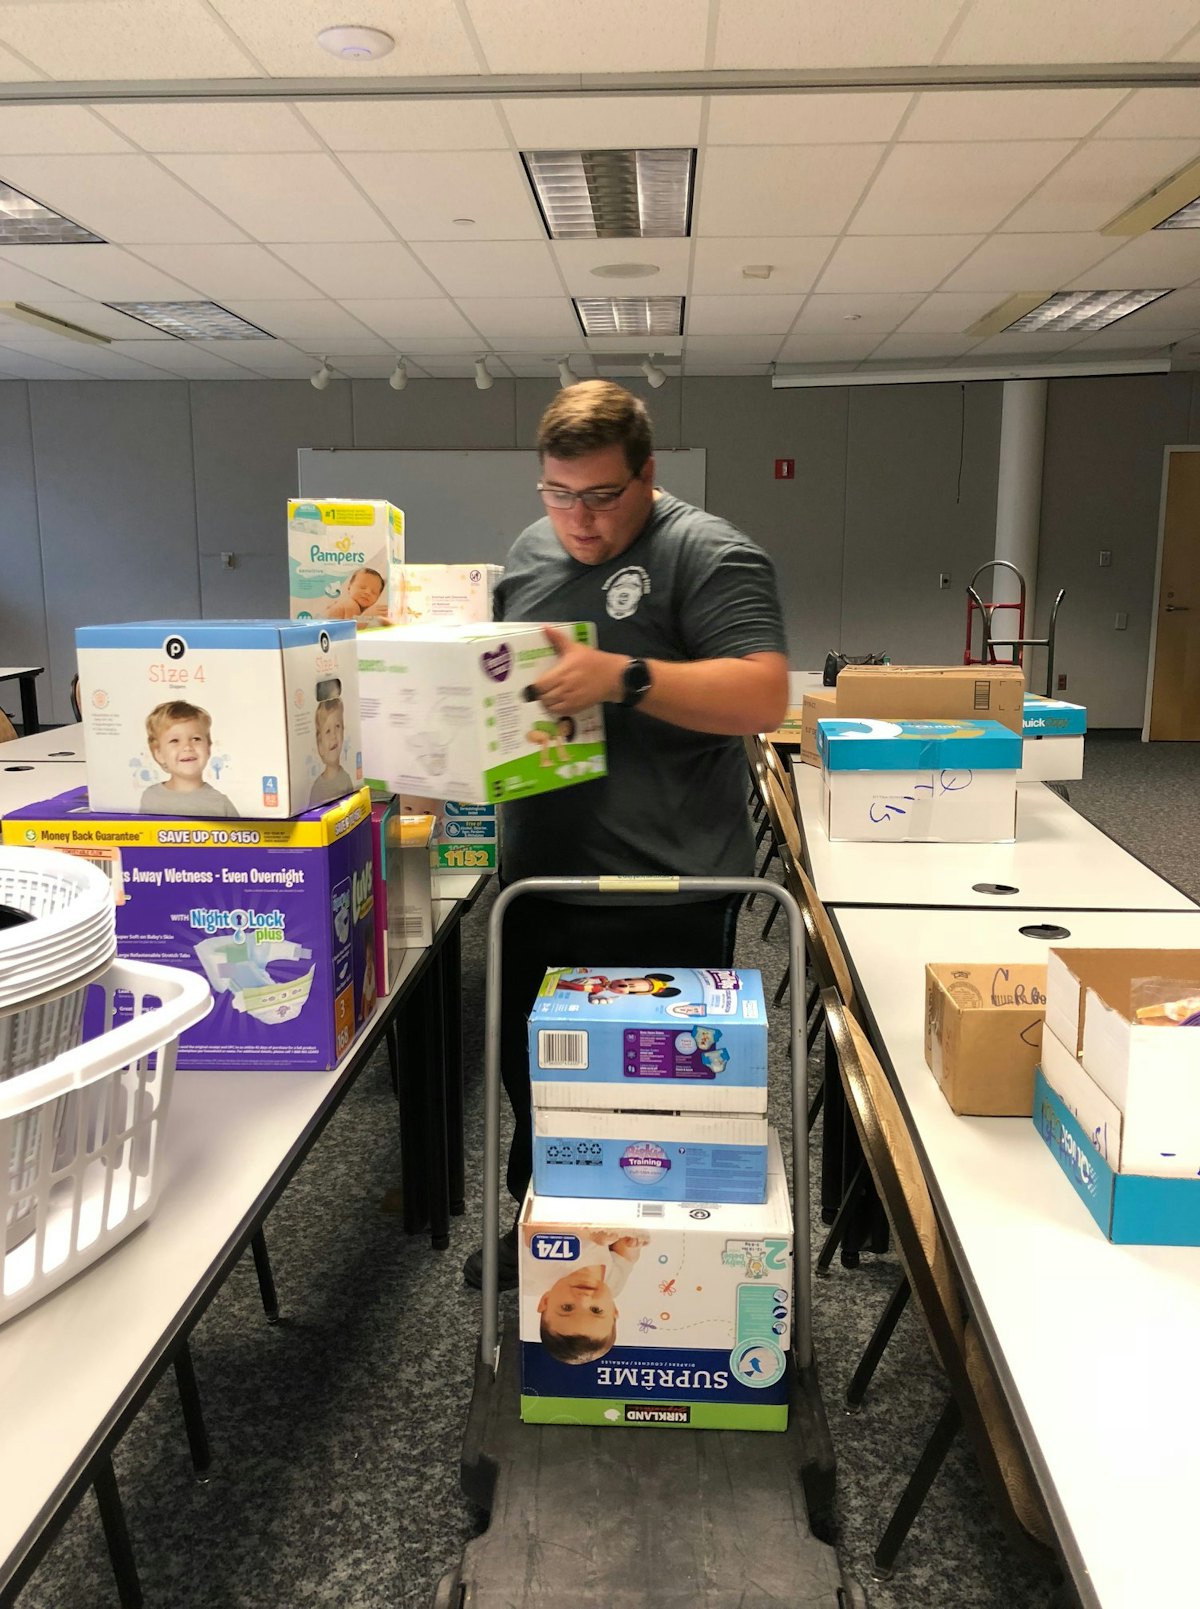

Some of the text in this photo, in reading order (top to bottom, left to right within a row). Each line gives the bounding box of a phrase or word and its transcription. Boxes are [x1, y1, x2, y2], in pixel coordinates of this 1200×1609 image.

[310, 544, 365, 565] Pampers
[148, 664, 206, 683] Size 4
[315, 656, 333, 673] Size
[266, 777, 274, 788] 4
[41, 830, 70, 843] Money
[72, 830, 94, 841] Back
[158, 830, 190, 843] SAVE
[192, 830, 210, 843] UP
[211, 830, 229, 843] TO
[230, 830, 261, 844] $150
[444, 850, 489, 867] 1152
[133, 867, 163, 887] Away
[164, 867, 214, 883] Wetness
[221, 867, 249, 883] Even
[250, 867, 305, 887] Overnight
[170, 908, 285, 934] WITH Night Lock
[255, 927, 284, 944] plus
[339, 999, 346, 1018] 3
[628, 1158, 663, 1168] Training
[536, 1239, 574, 1259] 174
[764, 1240, 789, 1271] 2
[597, 1367, 728, 1391] SUPRÊME
[626, 1411, 688, 1423] KIRKLAND
